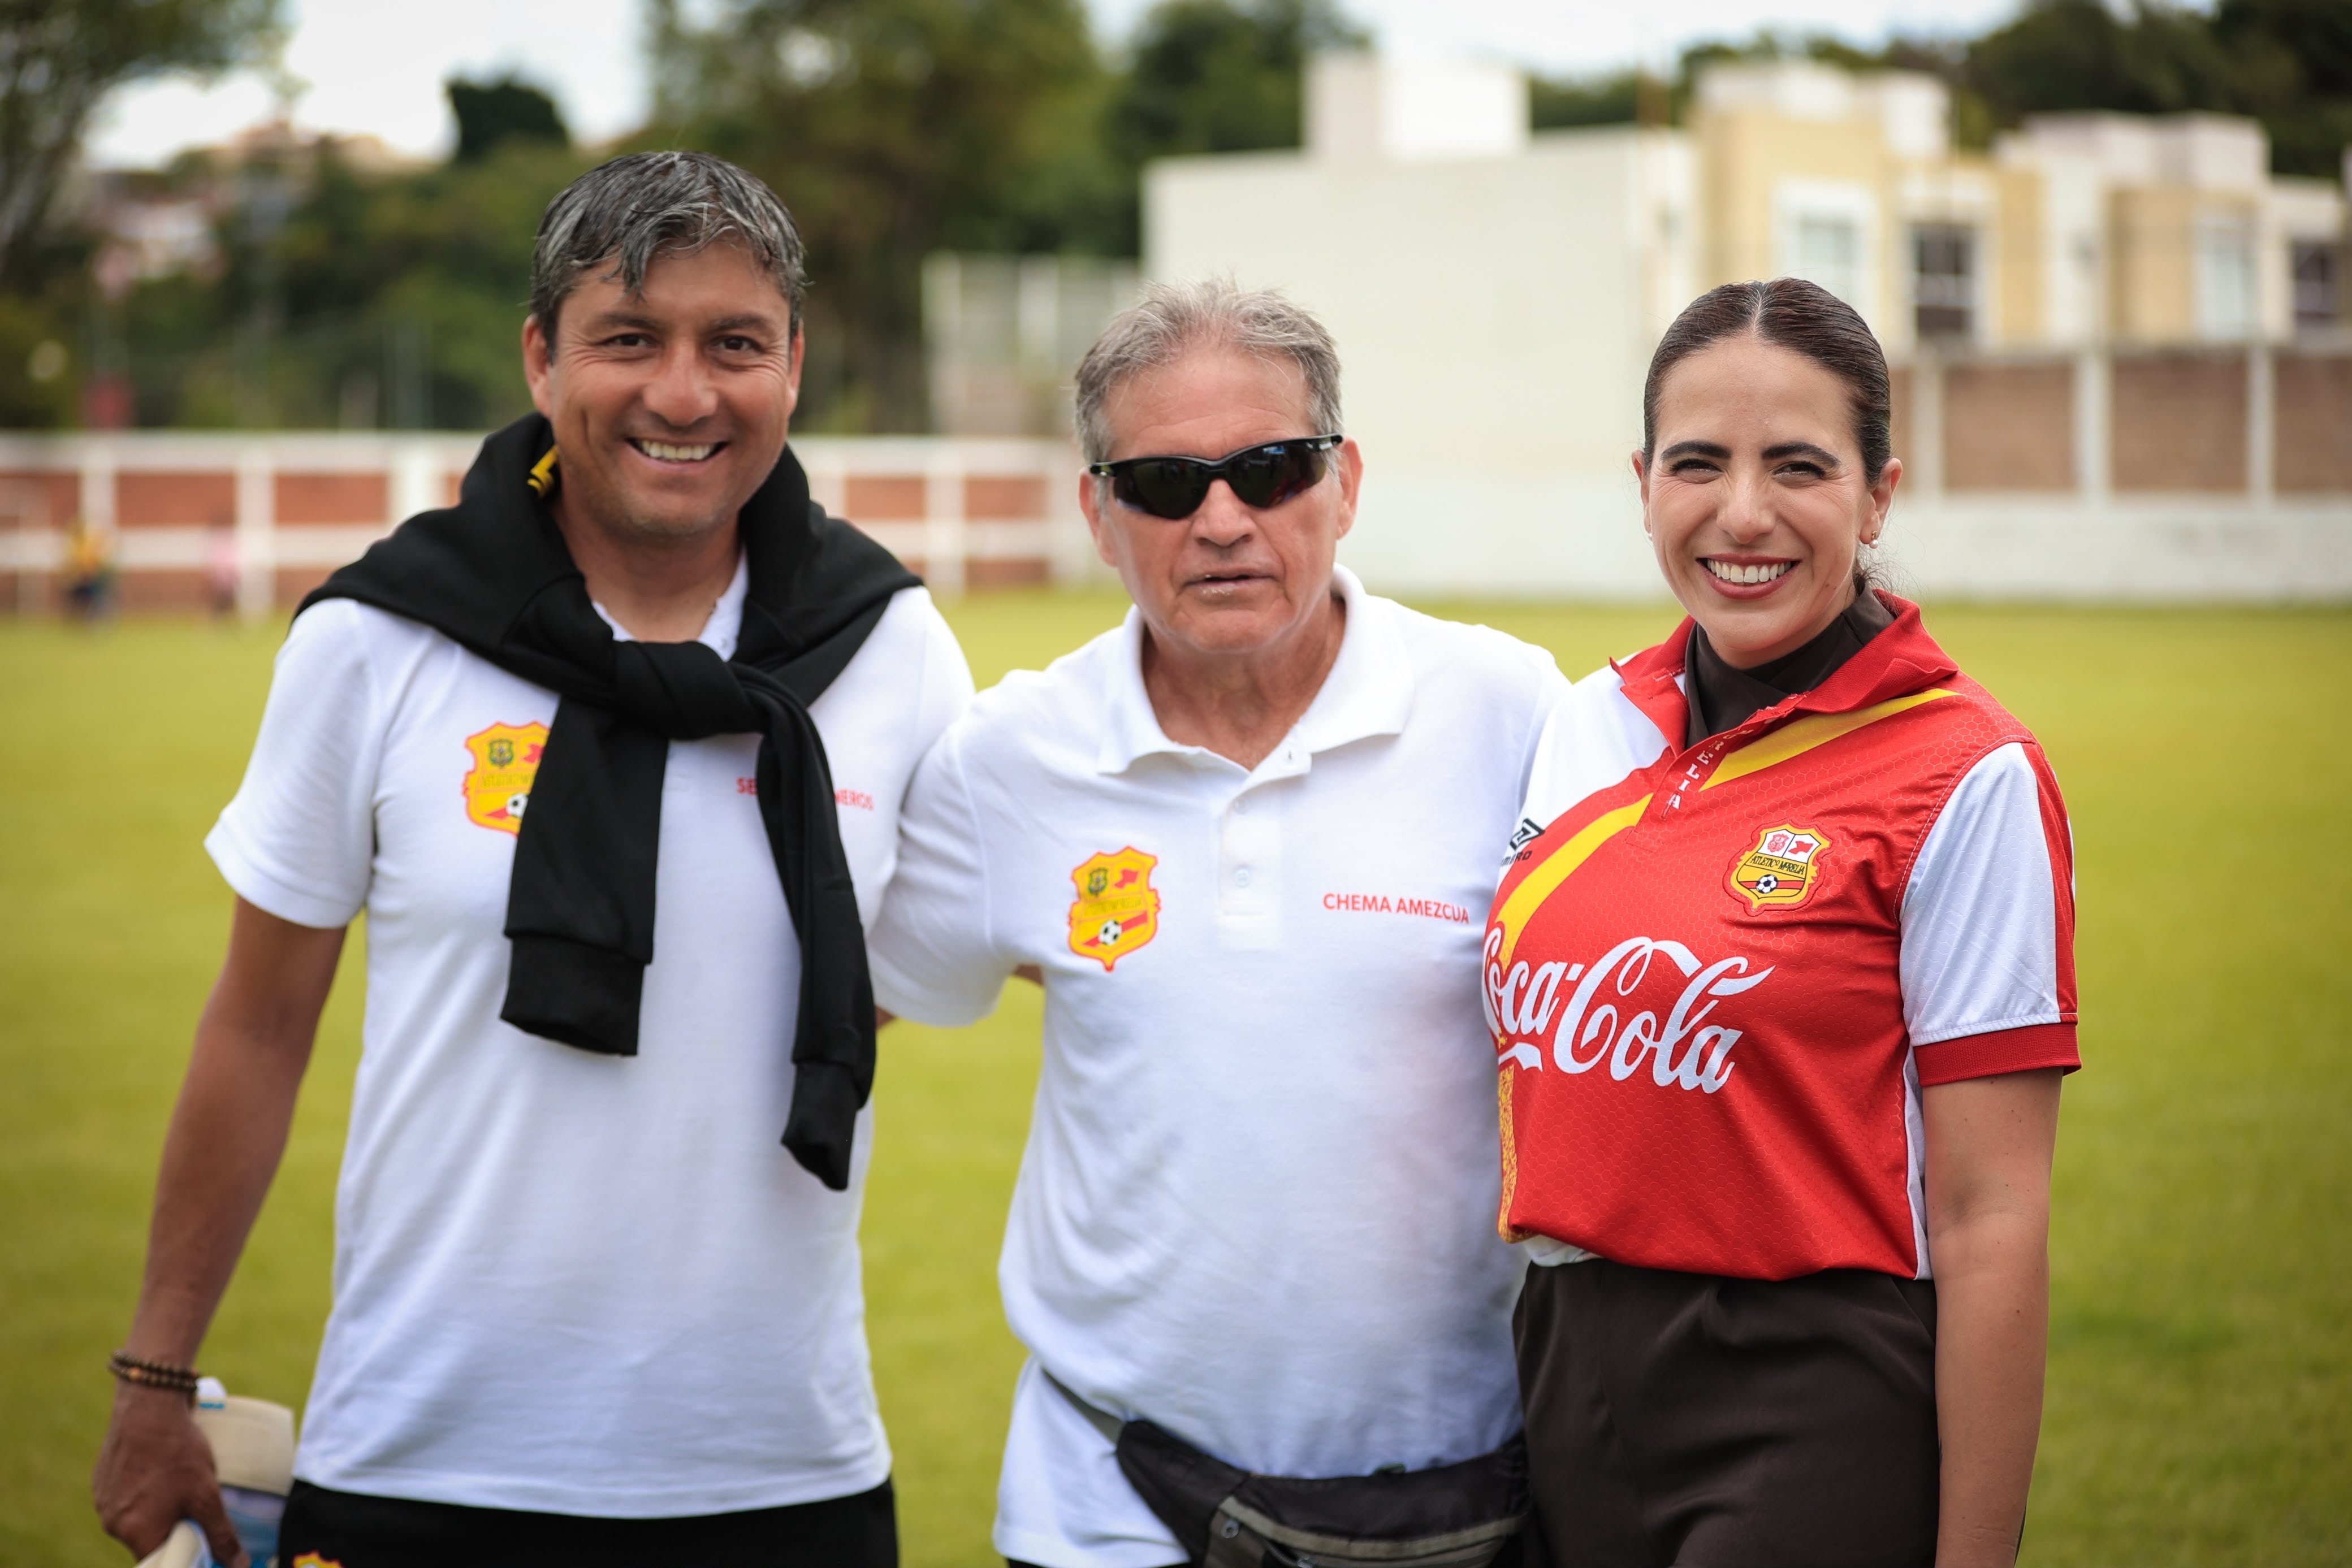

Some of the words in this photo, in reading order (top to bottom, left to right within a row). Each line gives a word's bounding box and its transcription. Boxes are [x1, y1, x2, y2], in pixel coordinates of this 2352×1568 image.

[1779, 861, 1805, 875] MORELIA
[1323, 893, 1392, 912] CHEMA
[1396, 897, 1469, 924] AMEZCUA
[1481, 928, 1776, 1093] Coca-Cola
